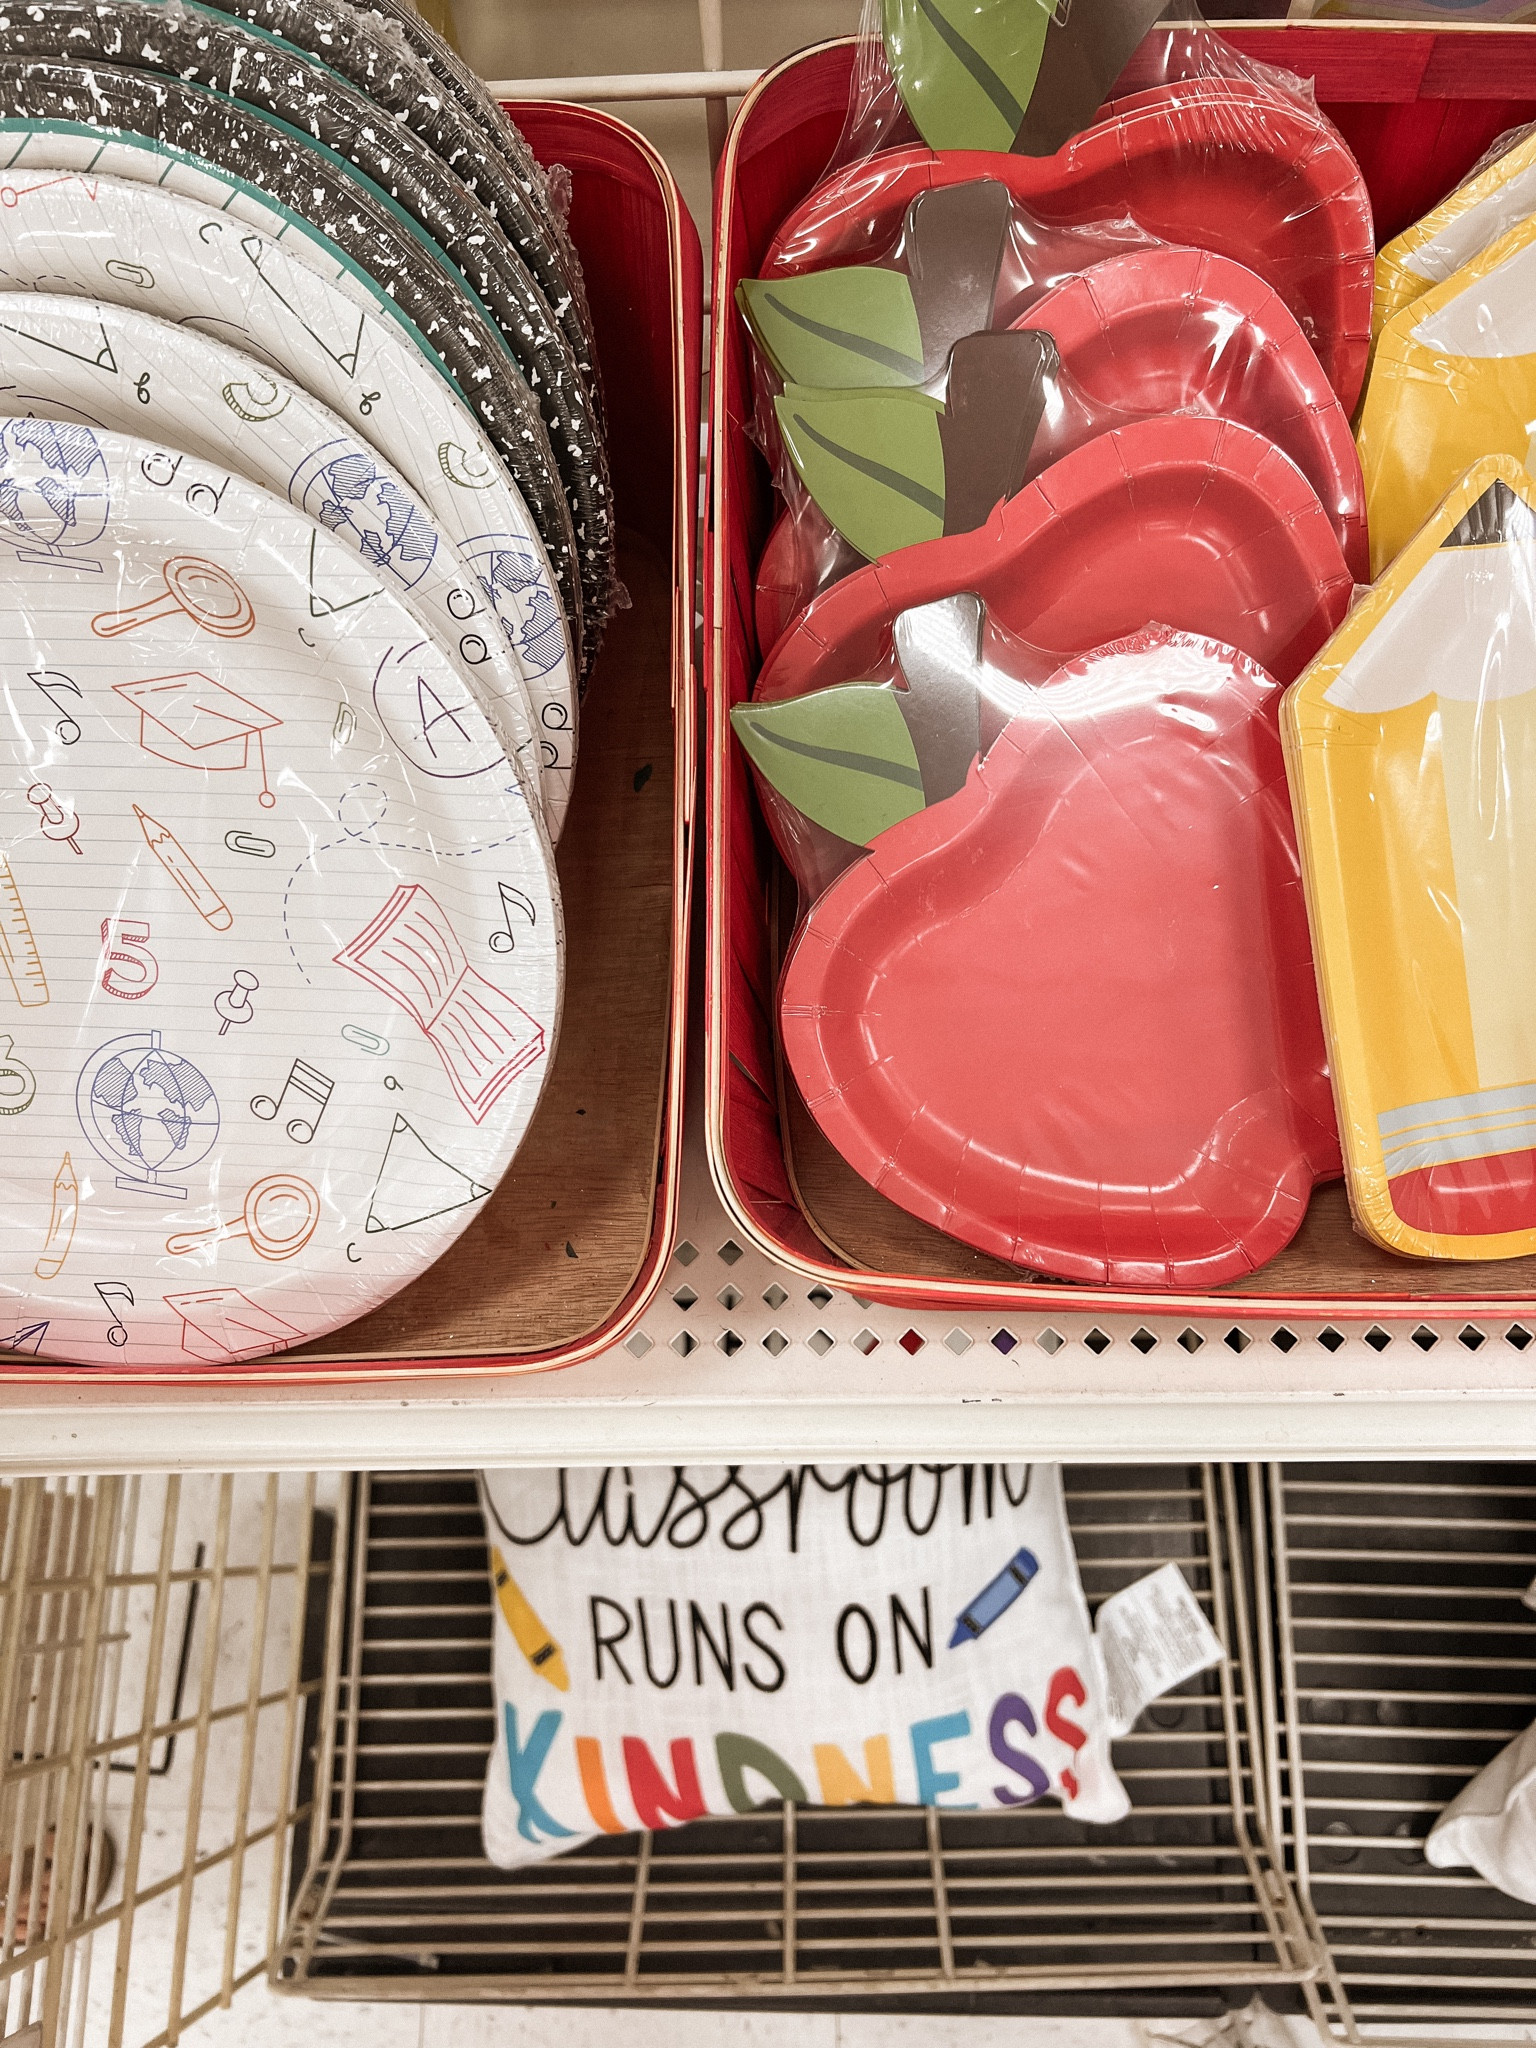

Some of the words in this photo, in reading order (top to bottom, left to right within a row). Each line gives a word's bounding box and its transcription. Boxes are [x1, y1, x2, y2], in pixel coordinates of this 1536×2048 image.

[413, 675, 472, 759] A
[101, 917, 159, 1000] 5
[589, 1595, 785, 1693] RUNS
[835, 1586, 936, 1685] ON
[502, 1665, 1087, 1845] KINDNESS
